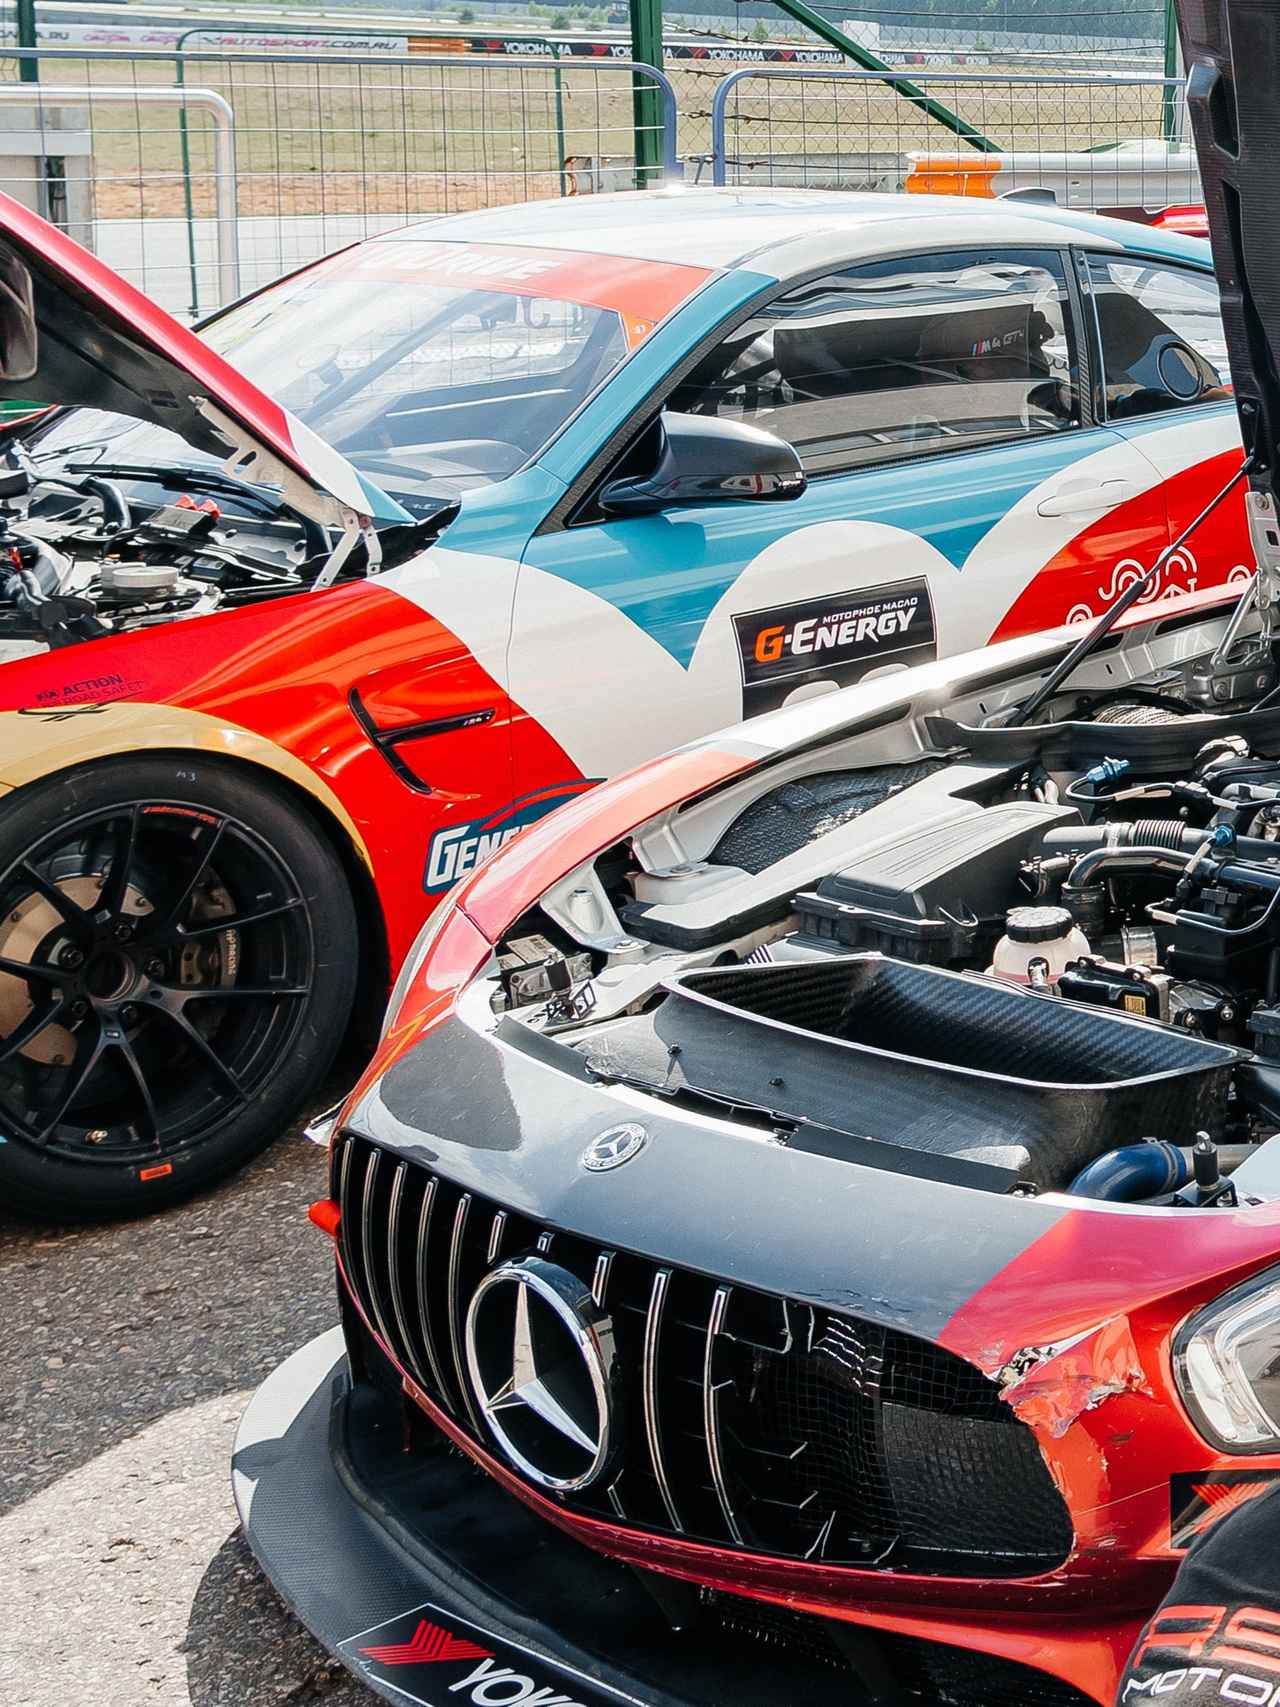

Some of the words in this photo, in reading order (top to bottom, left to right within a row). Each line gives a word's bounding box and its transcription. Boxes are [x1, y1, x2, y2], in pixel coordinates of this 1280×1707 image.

[708, 49, 765, 61] YOKOHAMA
[795, 51, 843, 63] YOKOHAMA
[822, 604, 882, 625] МОТОРНОЕ
[882, 596, 919, 616] МАСЛО
[36, 689, 59, 702] FIA
[63, 674, 123, 696] ACTION
